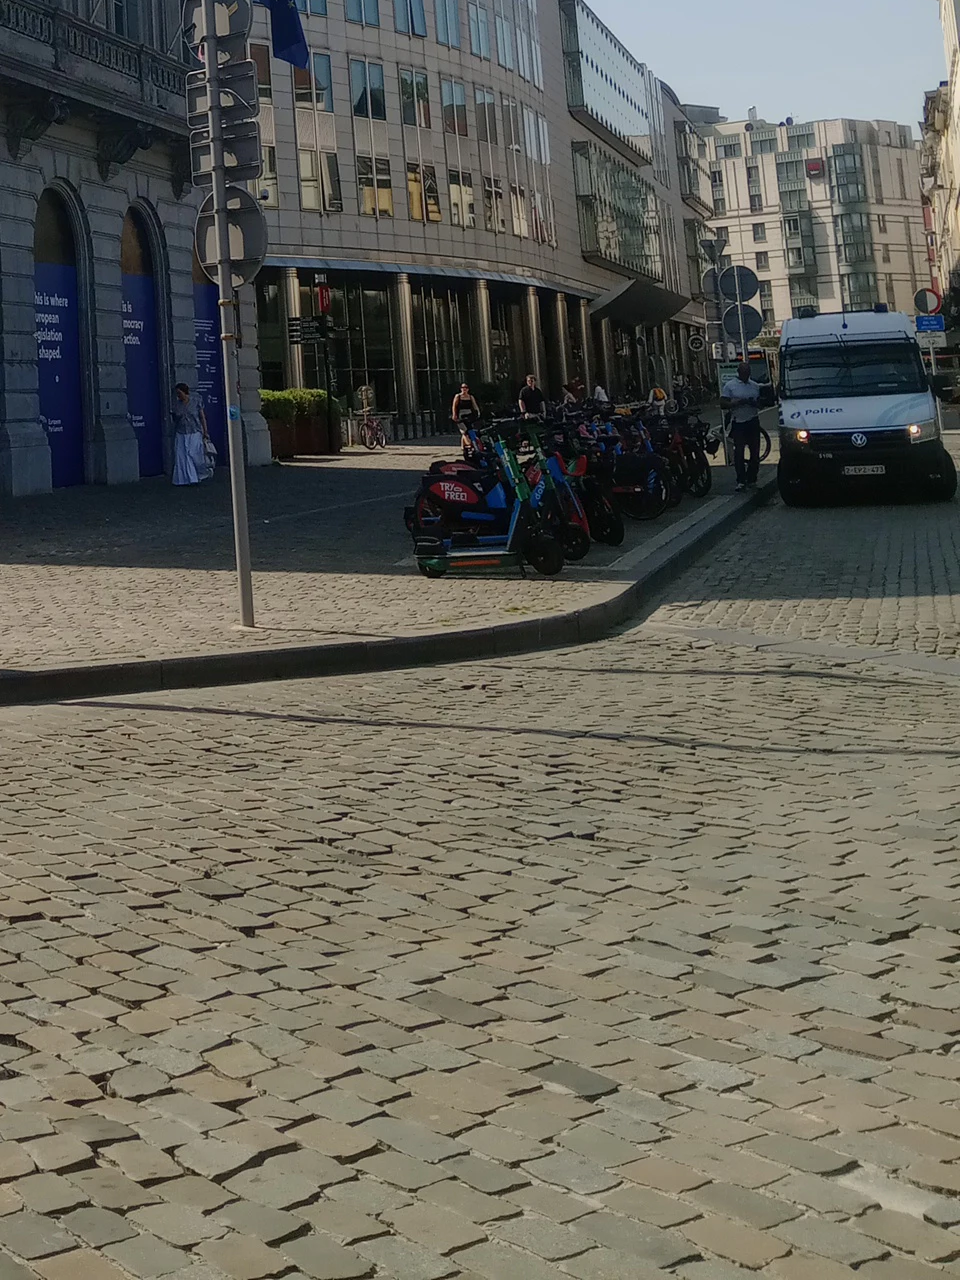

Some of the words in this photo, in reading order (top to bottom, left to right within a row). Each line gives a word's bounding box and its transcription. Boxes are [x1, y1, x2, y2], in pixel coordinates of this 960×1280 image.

[34, 291, 43, 305] his
[43, 292, 49, 305] is
[50, 293, 68, 307] where
[35, 313, 60, 326] uropean
[122, 319, 144, 332] mocracy
[33, 327, 63, 344] egislation
[38, 345, 62, 361] shaped.
[805, 407, 844, 416] Police
[440, 482, 455, 491] TRY
